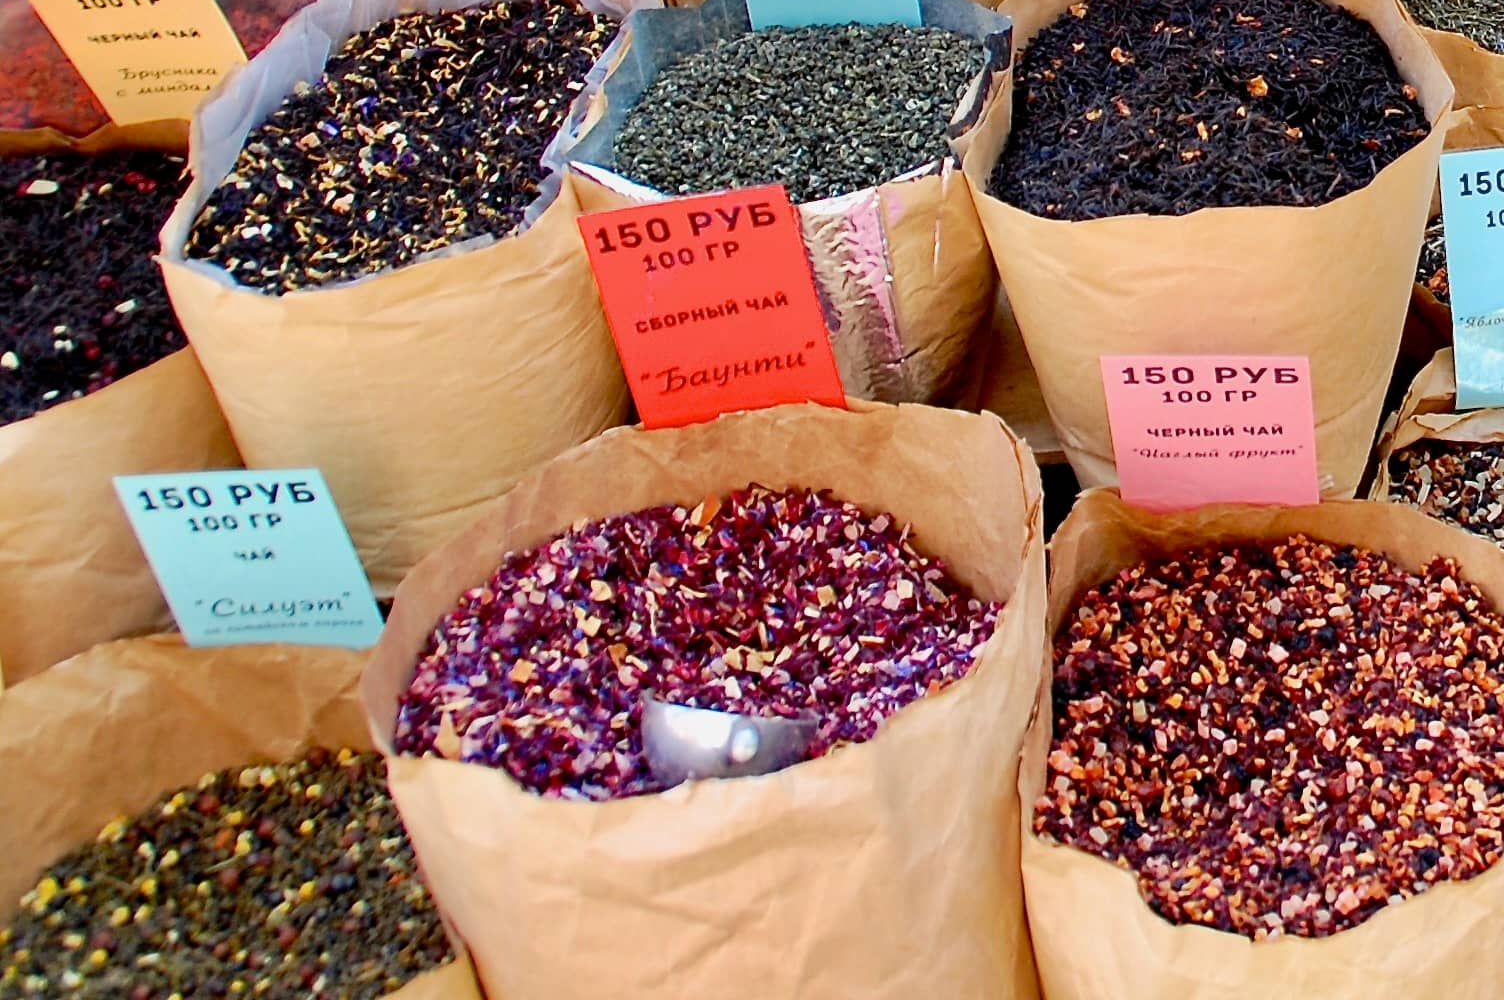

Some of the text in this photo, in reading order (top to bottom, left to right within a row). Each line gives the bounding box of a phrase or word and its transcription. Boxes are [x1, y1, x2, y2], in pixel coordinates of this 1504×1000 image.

[635, 291, 789, 334] СБОРНЫЙ ЧАЙ
[640, 340, 815, 394] "Баунти"
[138, 482, 316, 511] 150 РУБ
